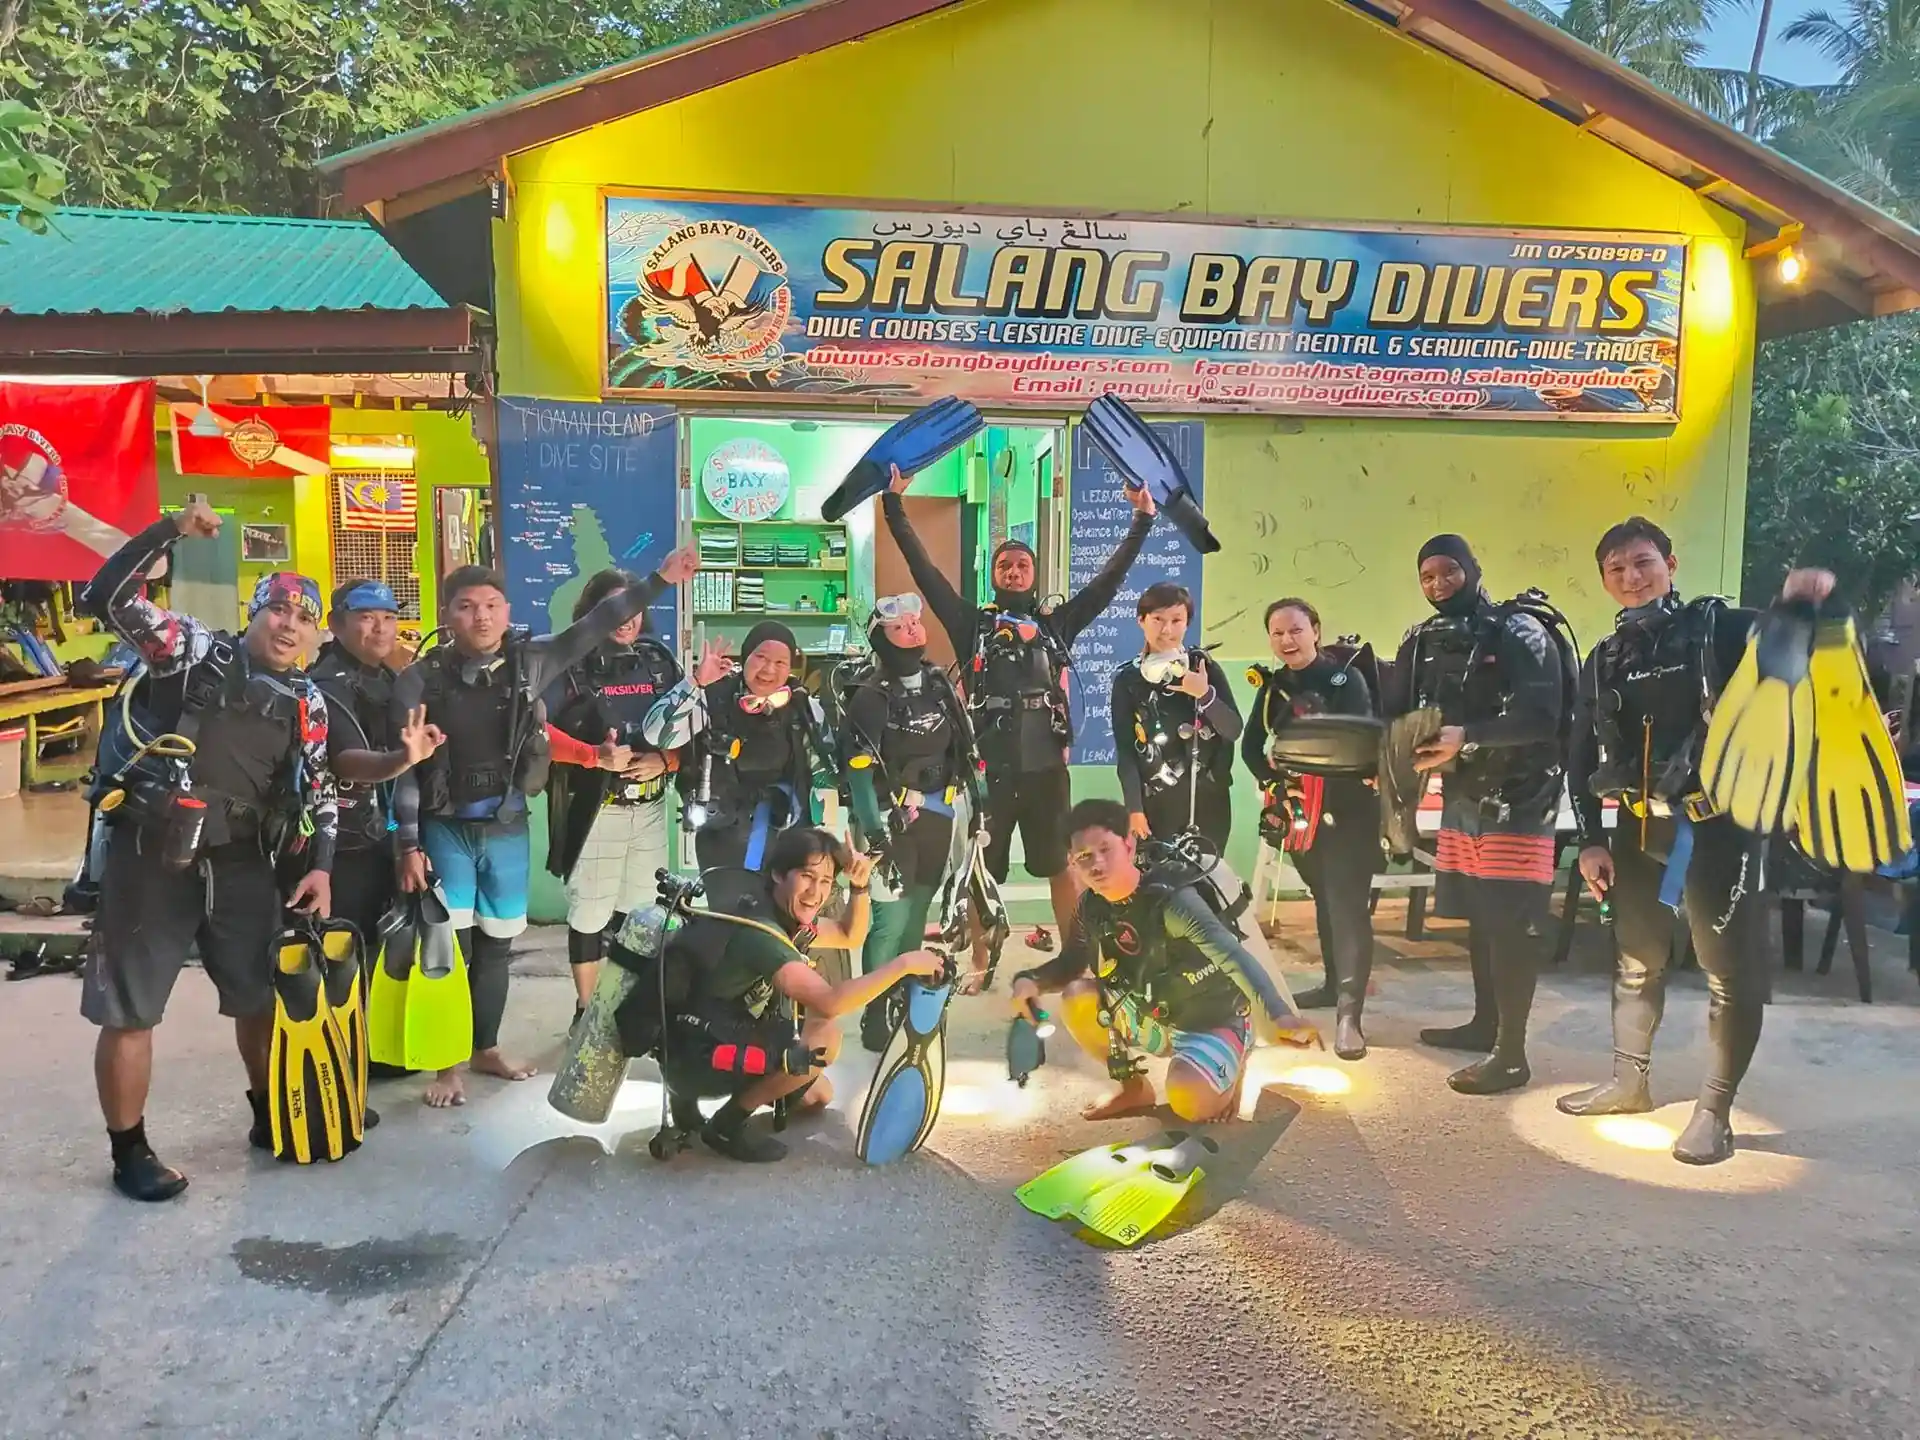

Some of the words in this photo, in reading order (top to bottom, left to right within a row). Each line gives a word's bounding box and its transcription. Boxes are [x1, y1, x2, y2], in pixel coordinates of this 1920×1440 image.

[646, 225, 697, 270] SALANG
[699, 221, 734, 236] BAY
[996, 218, 1048, 247] باي
[1509, 243, 1542, 259] JM
[815, 238, 1167, 316] SALANG
[1179, 250, 1358, 325] BAY
[1368, 259, 1657, 336] DIVERS
[741, 327, 777, 360] TIOMAN
[772, 287, 789, 330] ISLAND
[806, 316, 864, 338] DIVE
[1294, 332, 1380, 355] RENTAL
[1387, 336, 1402, 356] &
[1585, 341, 1662, 363] TRAVEL
[1013, 375, 1084, 394] Email
[1464, 368, 1660, 389] salangbaydivers
[519, 406, 591, 435] TIOMAN
[597, 409, 655, 438] ISLAND
[539, 442, 580, 469] DIVE
[588, 443, 639, 477] SITE
[727, 470, 767, 490] BAY
[1081, 747, 1115, 763] LEARN
[319, 1062, 331, 1086] PRO
